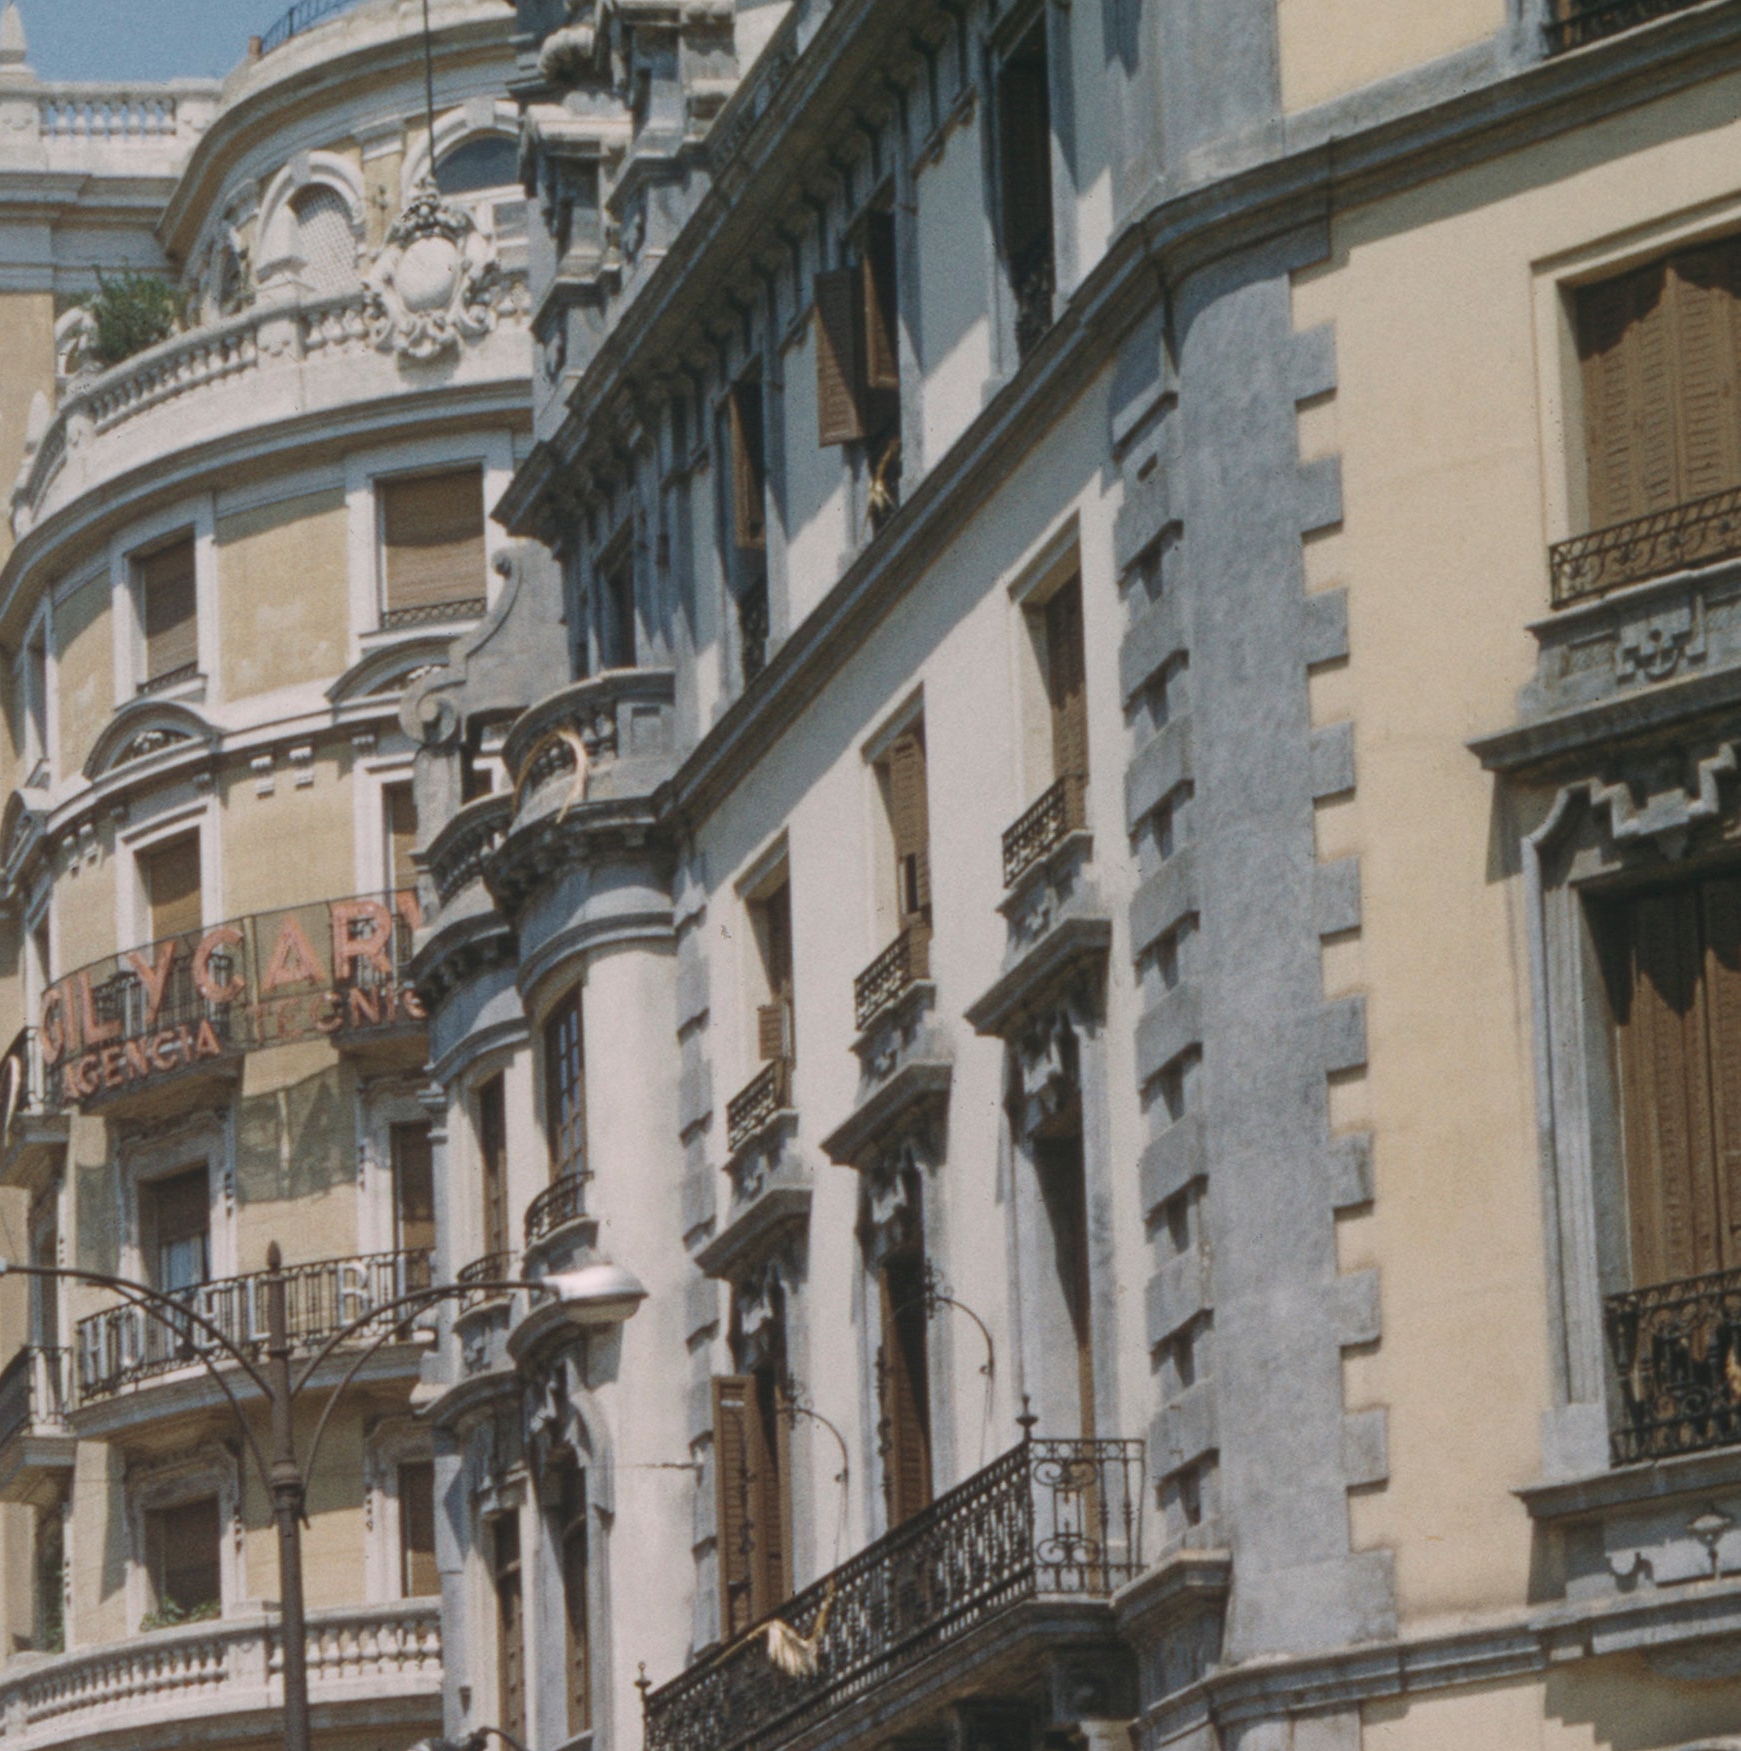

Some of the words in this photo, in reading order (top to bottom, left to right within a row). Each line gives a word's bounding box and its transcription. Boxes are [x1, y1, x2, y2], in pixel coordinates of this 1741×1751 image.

[39, 972, 120, 1065] GIL
[128, 940, 177, 1023] Y
[63, 1018, 220, 1099] AGENCIA
